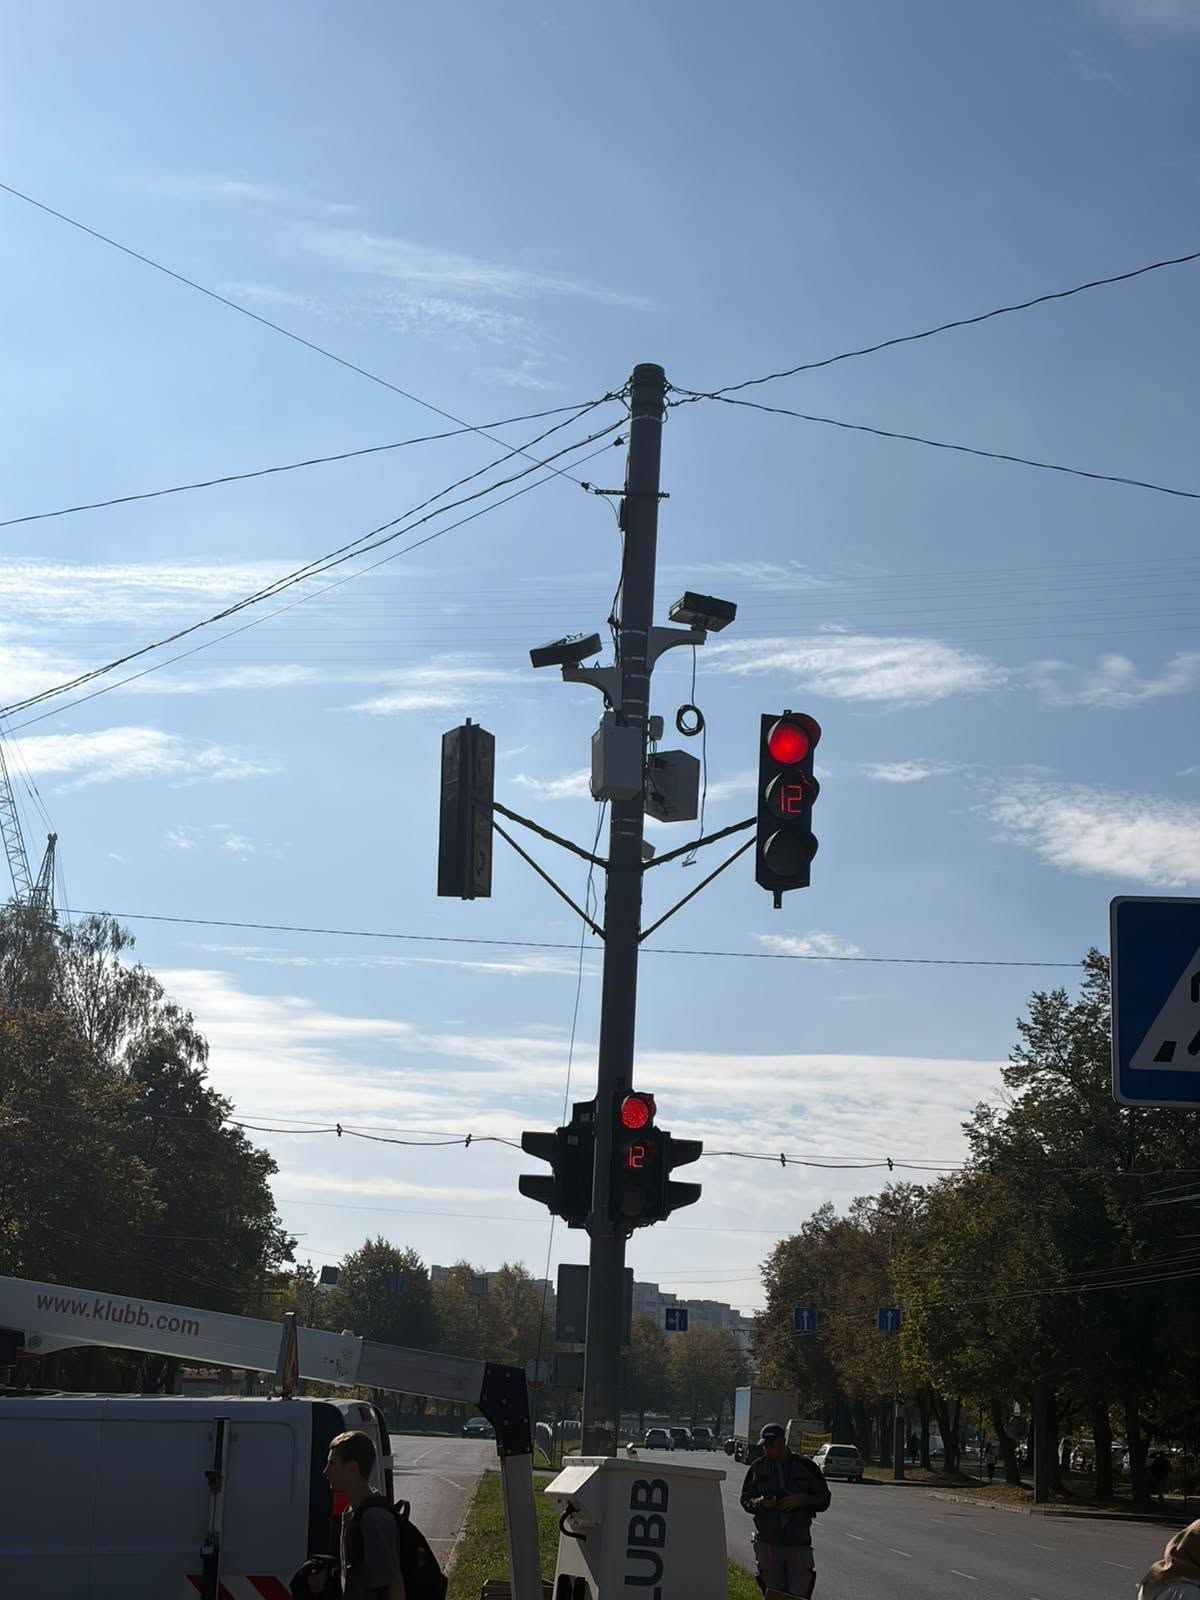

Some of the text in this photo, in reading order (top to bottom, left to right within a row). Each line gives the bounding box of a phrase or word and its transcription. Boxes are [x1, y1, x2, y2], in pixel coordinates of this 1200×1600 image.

[781, 785, 802, 813] 12
[629, 1146, 645, 1168] 12
[36, 1294, 200, 1336] www.klubb.com
